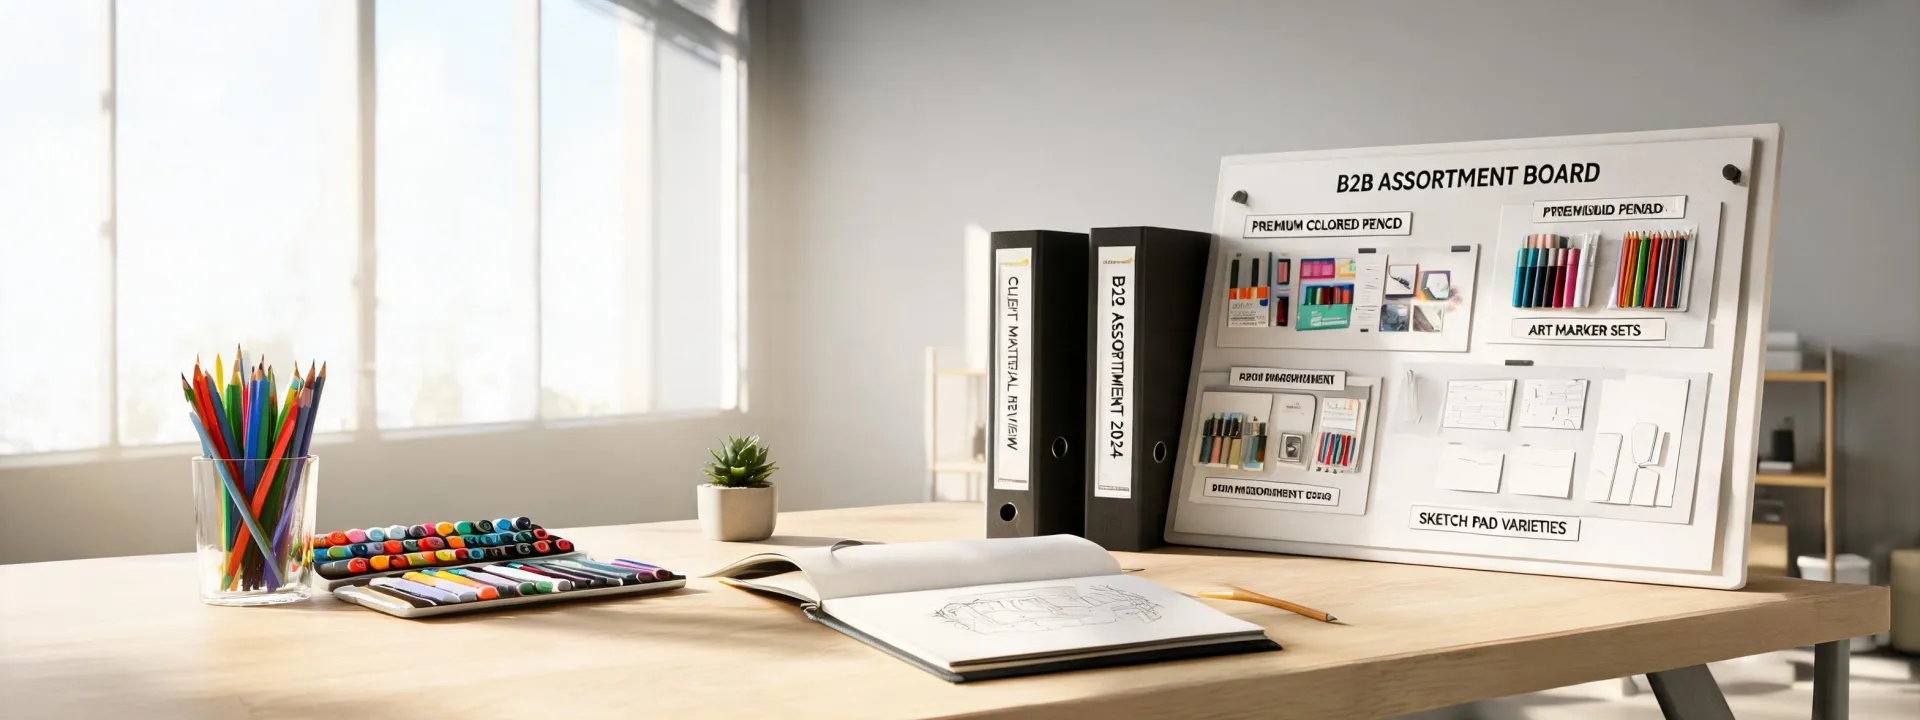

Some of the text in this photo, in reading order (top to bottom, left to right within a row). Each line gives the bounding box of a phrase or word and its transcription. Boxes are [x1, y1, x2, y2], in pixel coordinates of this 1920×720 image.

[1336, 162, 1601, 193] B2B ASSORTMENT BOARD
[1251, 219, 1303, 233] PREMIUM
[1306, 218, 1359, 231] COLORED
[1528, 323, 1642, 336] ART MARKER SETS
[1109, 421, 1124, 459] 2024
[1419, 512, 1567, 535] SKETCH PAD VARIETIES
